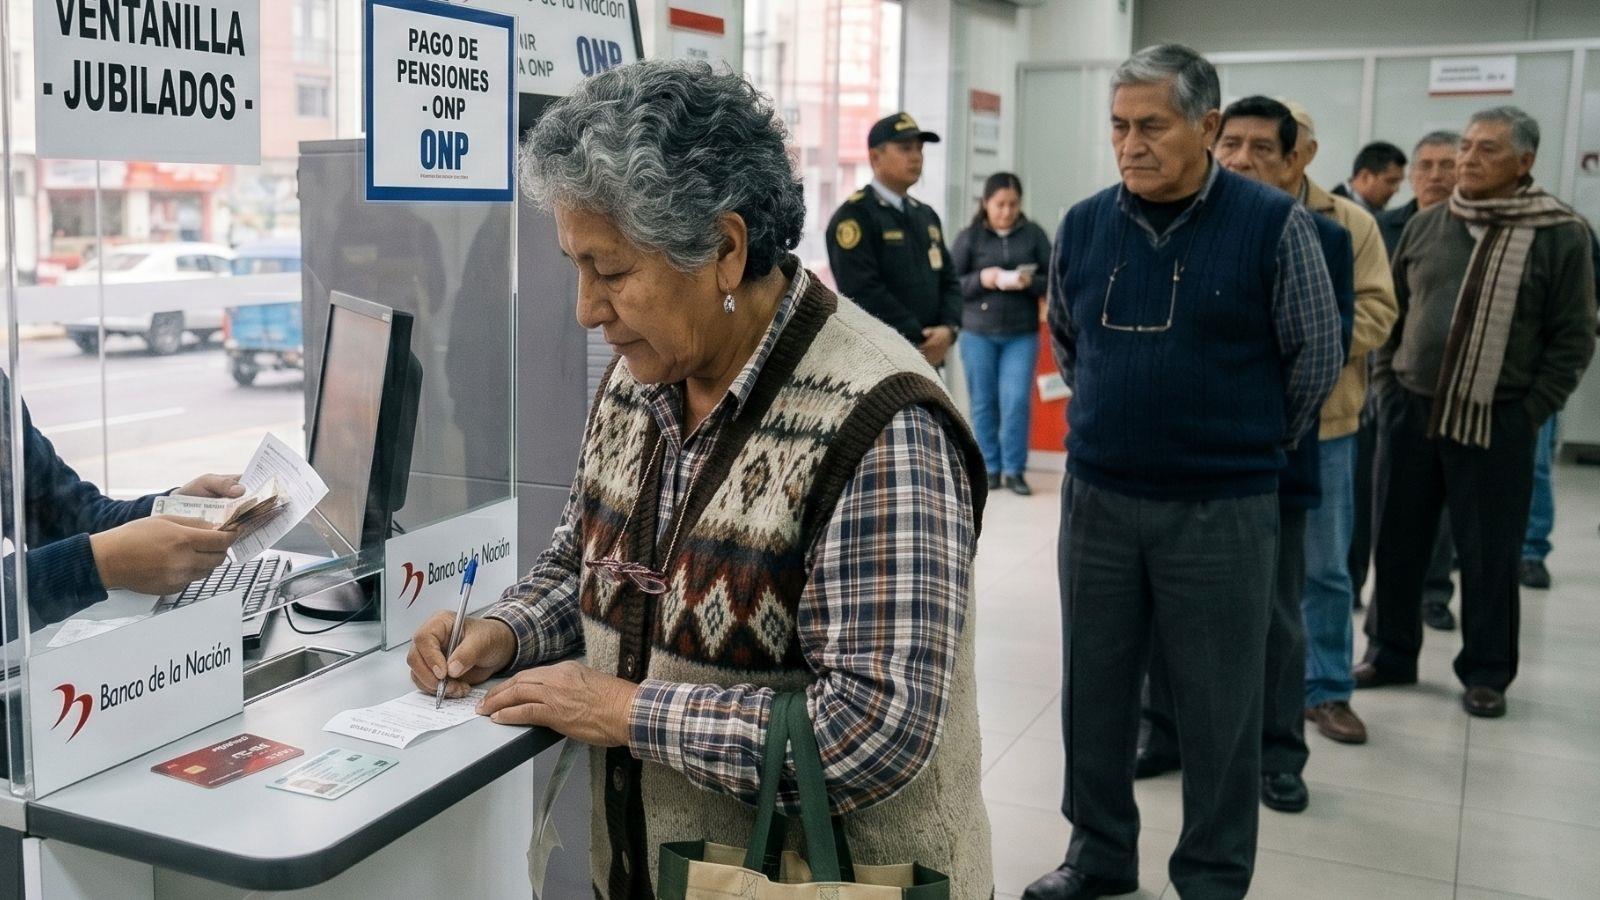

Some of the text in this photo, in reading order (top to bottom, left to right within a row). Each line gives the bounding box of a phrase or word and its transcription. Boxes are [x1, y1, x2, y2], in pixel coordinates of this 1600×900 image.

[55, 0, 245, 56] VENTANILLA
[409, 28, 478, 61] PAGO DE
[397, 59, 489, 93] PENSIONES
[528, 58, 554, 77] ONP
[576, 35, 622, 77] ONP
[64, 59, 236, 120] JUBILADOS
[432, 95, 466, 120] ONP
[420, 129, 469, 171] ONP
[428, 561, 455, 585] Banco
[458, 551, 469, 574] de
[481, 537, 510, 565] Nación
[100, 642, 231, 711] Banco de la Nación
